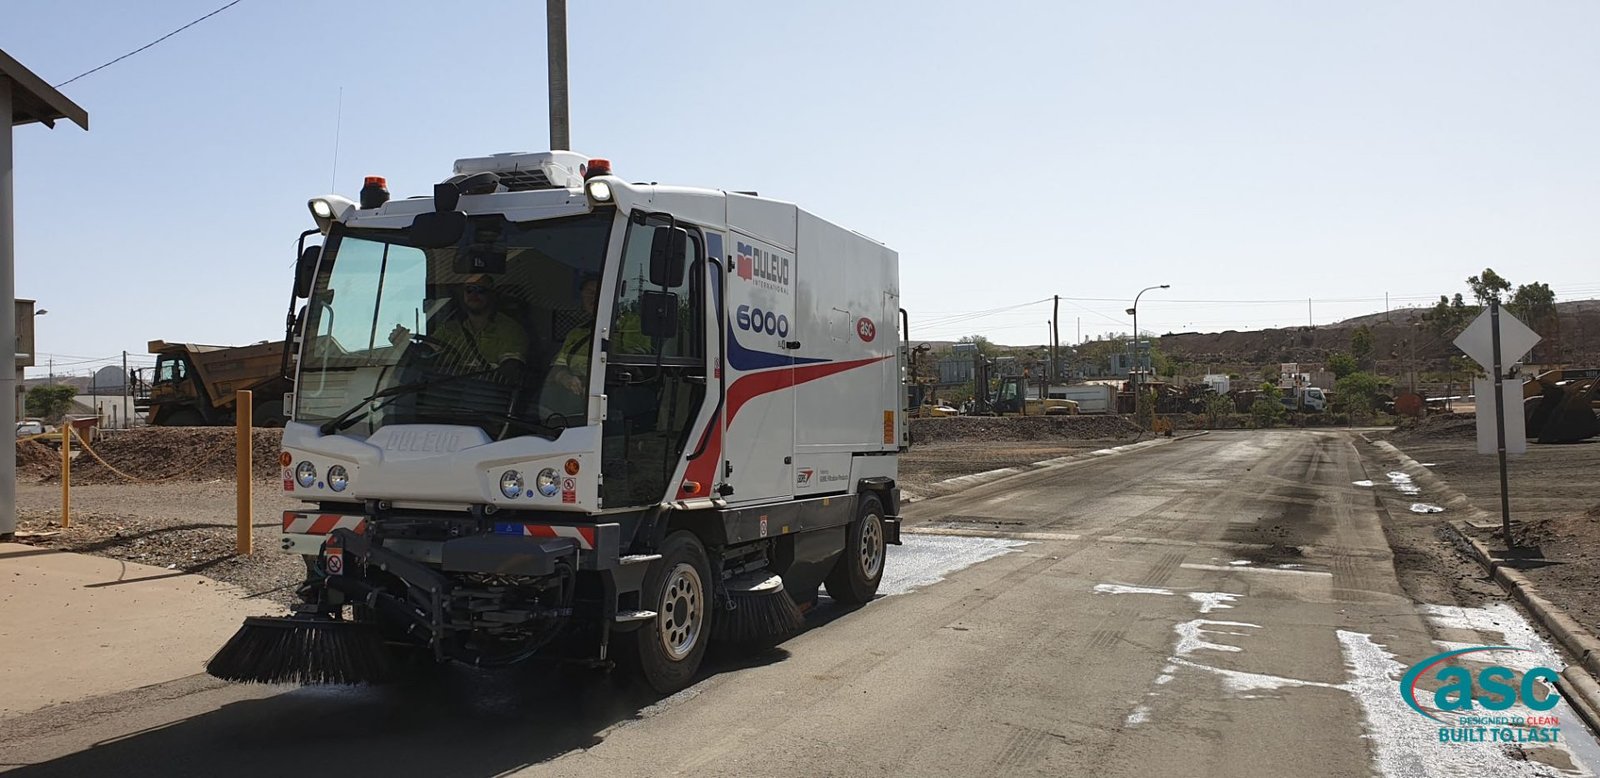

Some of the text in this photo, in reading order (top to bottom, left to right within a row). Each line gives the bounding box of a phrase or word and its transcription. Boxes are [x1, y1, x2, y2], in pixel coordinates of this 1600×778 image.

[753, 247, 789, 286] DULEVO
[752, 279, 789, 296] INTERNATIONAL
[736, 304, 788, 338] 6000
[860, 320, 874, 337] asc
